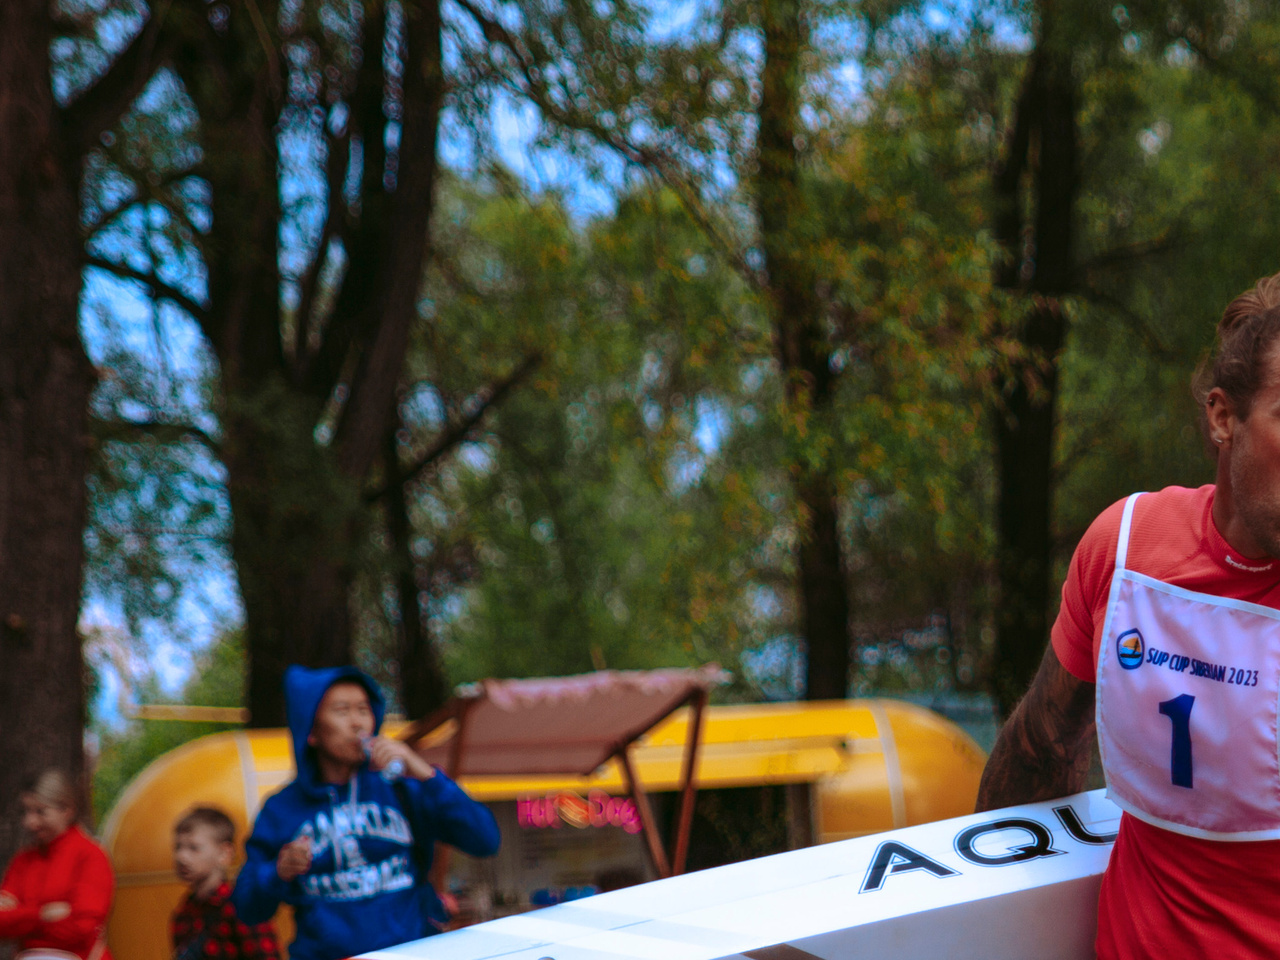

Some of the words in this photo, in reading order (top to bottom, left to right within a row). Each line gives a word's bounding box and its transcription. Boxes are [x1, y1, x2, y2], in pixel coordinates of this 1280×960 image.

[1146, 647, 1170, 666] SUP
[1168, 654, 1191, 672] CUP
[1227, 667, 1260, 687] 2023
[1158, 693, 1196, 789] 1
